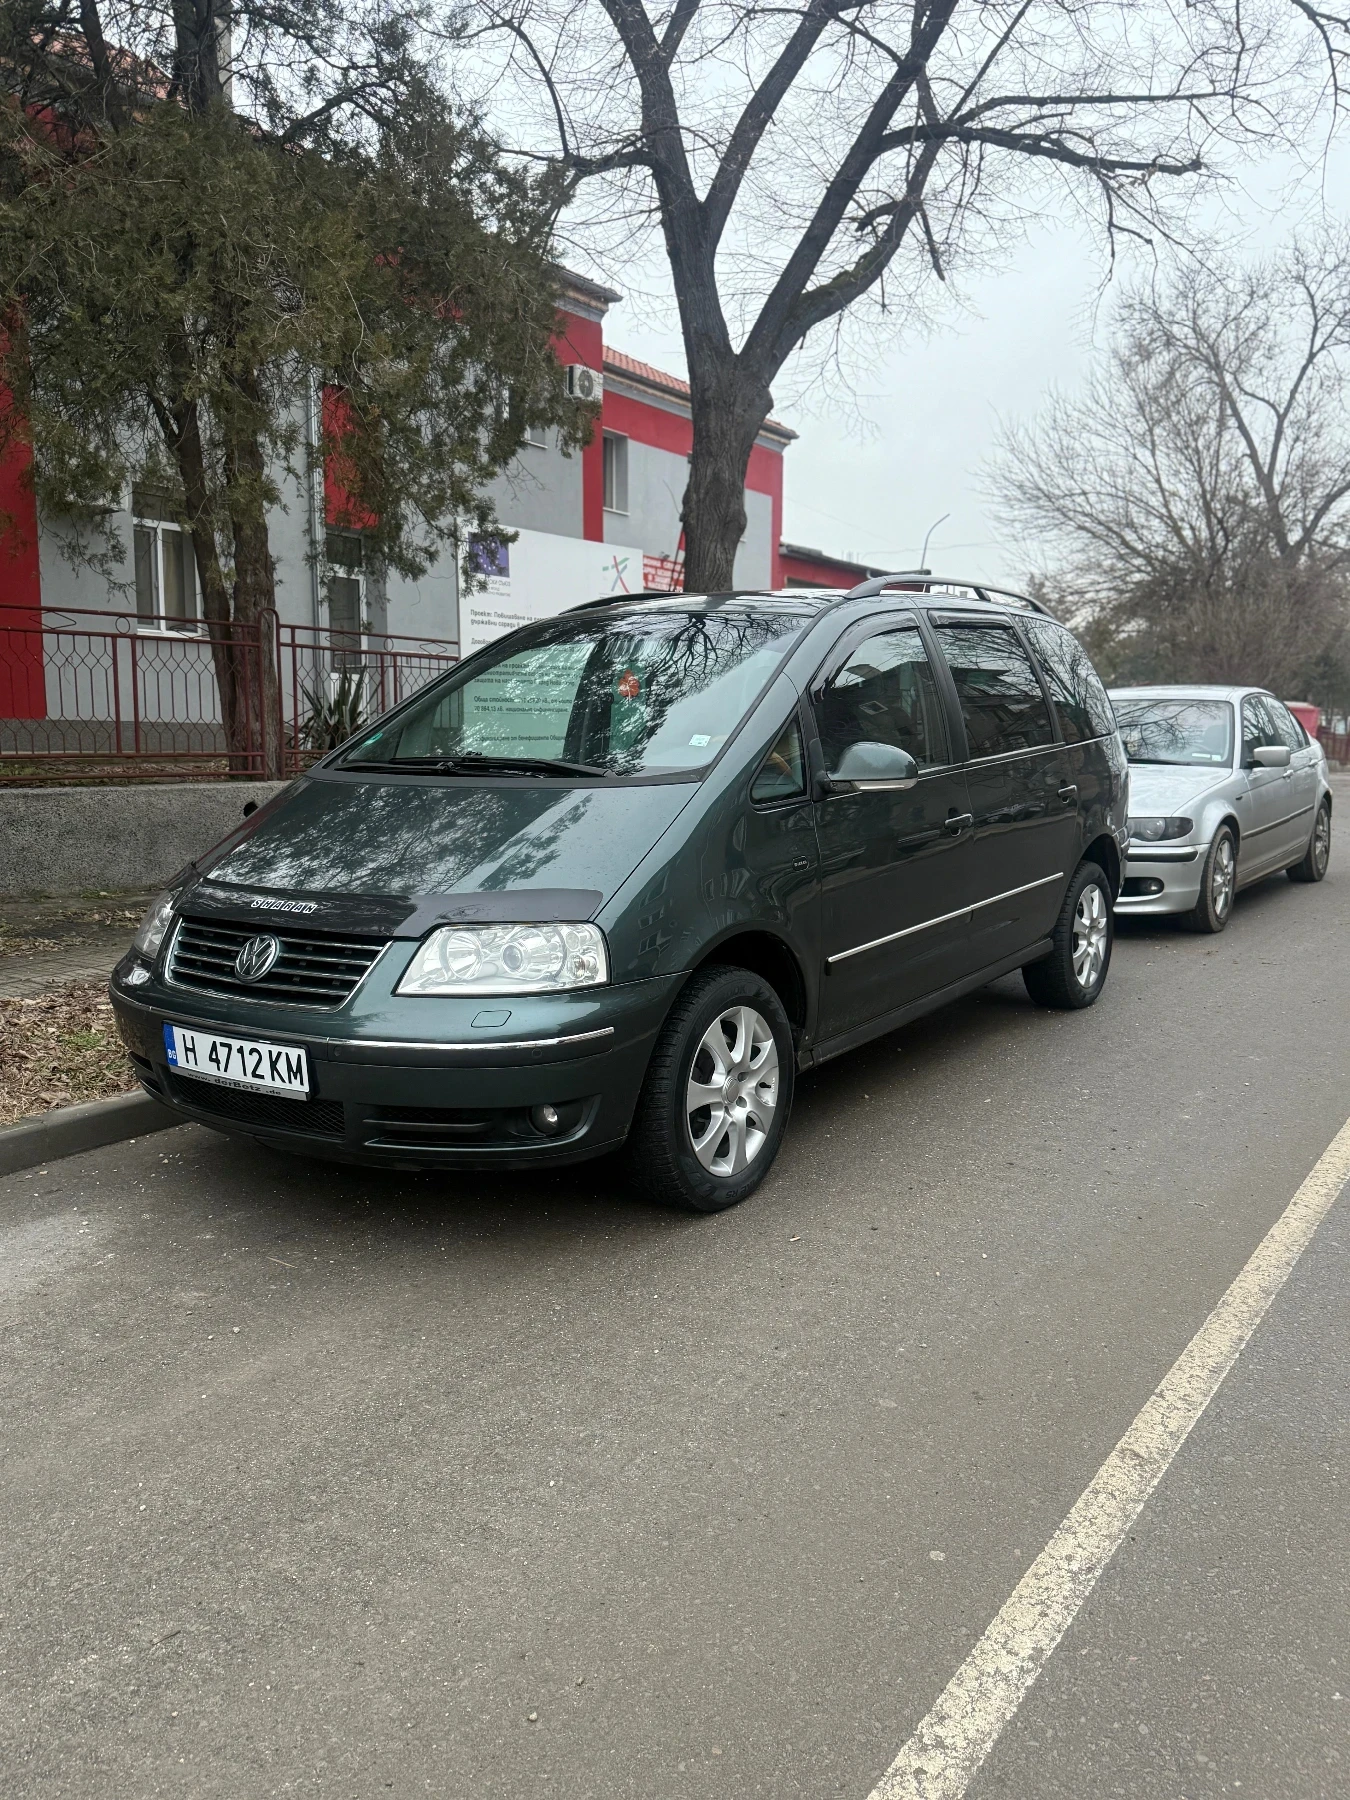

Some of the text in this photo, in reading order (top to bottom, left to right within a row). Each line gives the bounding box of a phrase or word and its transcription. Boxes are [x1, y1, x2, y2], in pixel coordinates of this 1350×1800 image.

[470, 609, 492, 617] Проект:
[251, 899, 318, 913] SHARAN
[167, 1048, 177, 1060] BG
[182, 1033, 304, 1087] H 4712KM
